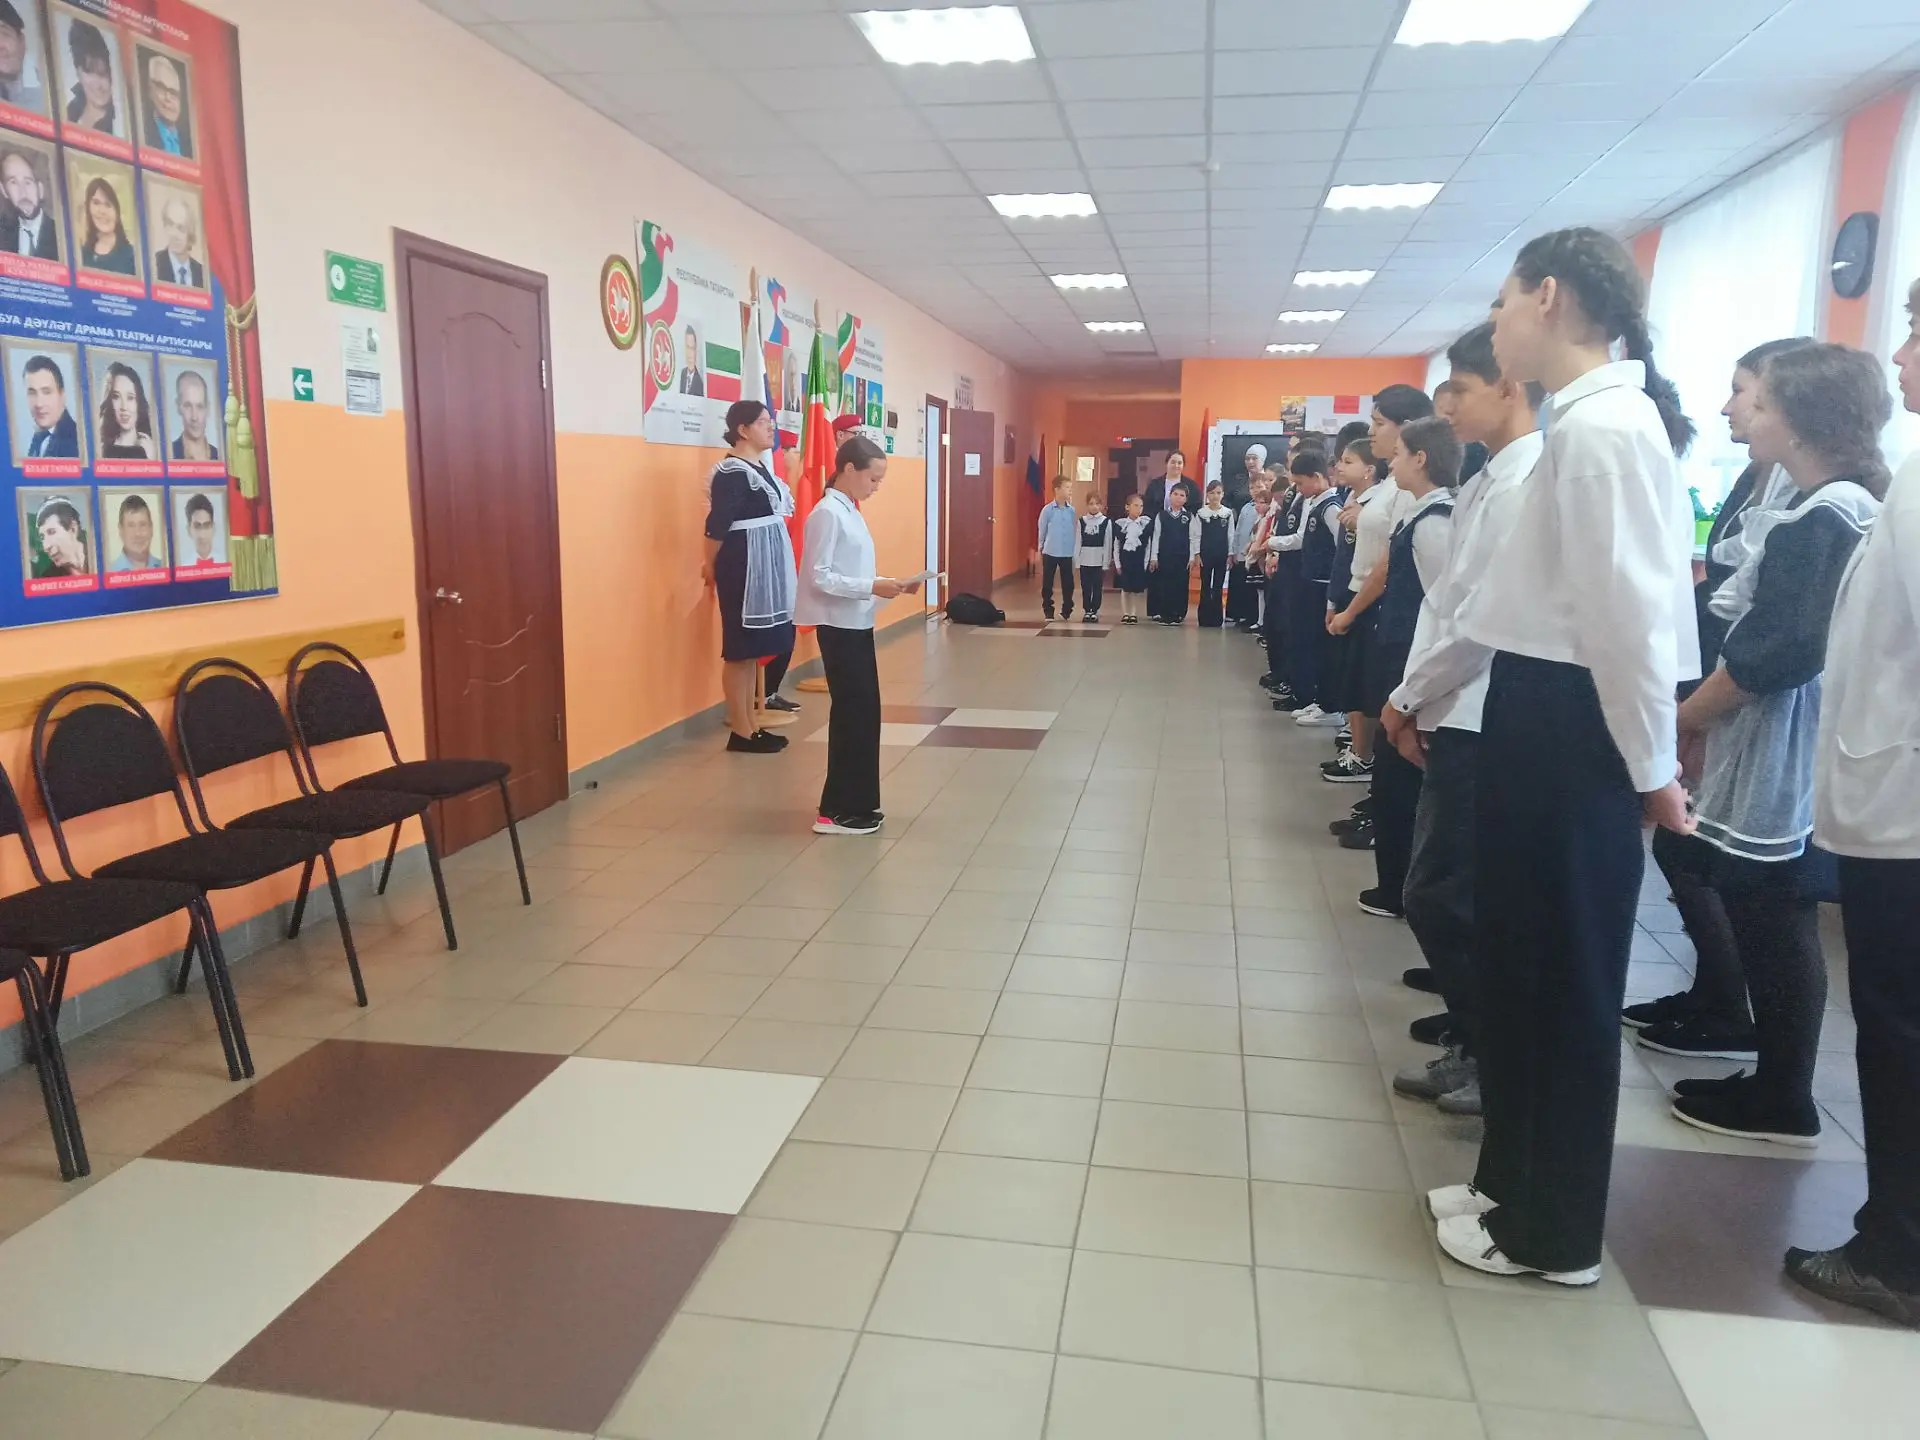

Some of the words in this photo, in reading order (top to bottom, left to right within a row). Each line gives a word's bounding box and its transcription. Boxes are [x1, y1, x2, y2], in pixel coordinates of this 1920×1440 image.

[0, 313, 21, 325] БУА
[74, 323, 114, 338] ДРАМА
[115, 329, 154, 343] ТЕАТРЫ
[156, 335, 213, 351] АРТИСЛАРЫ
